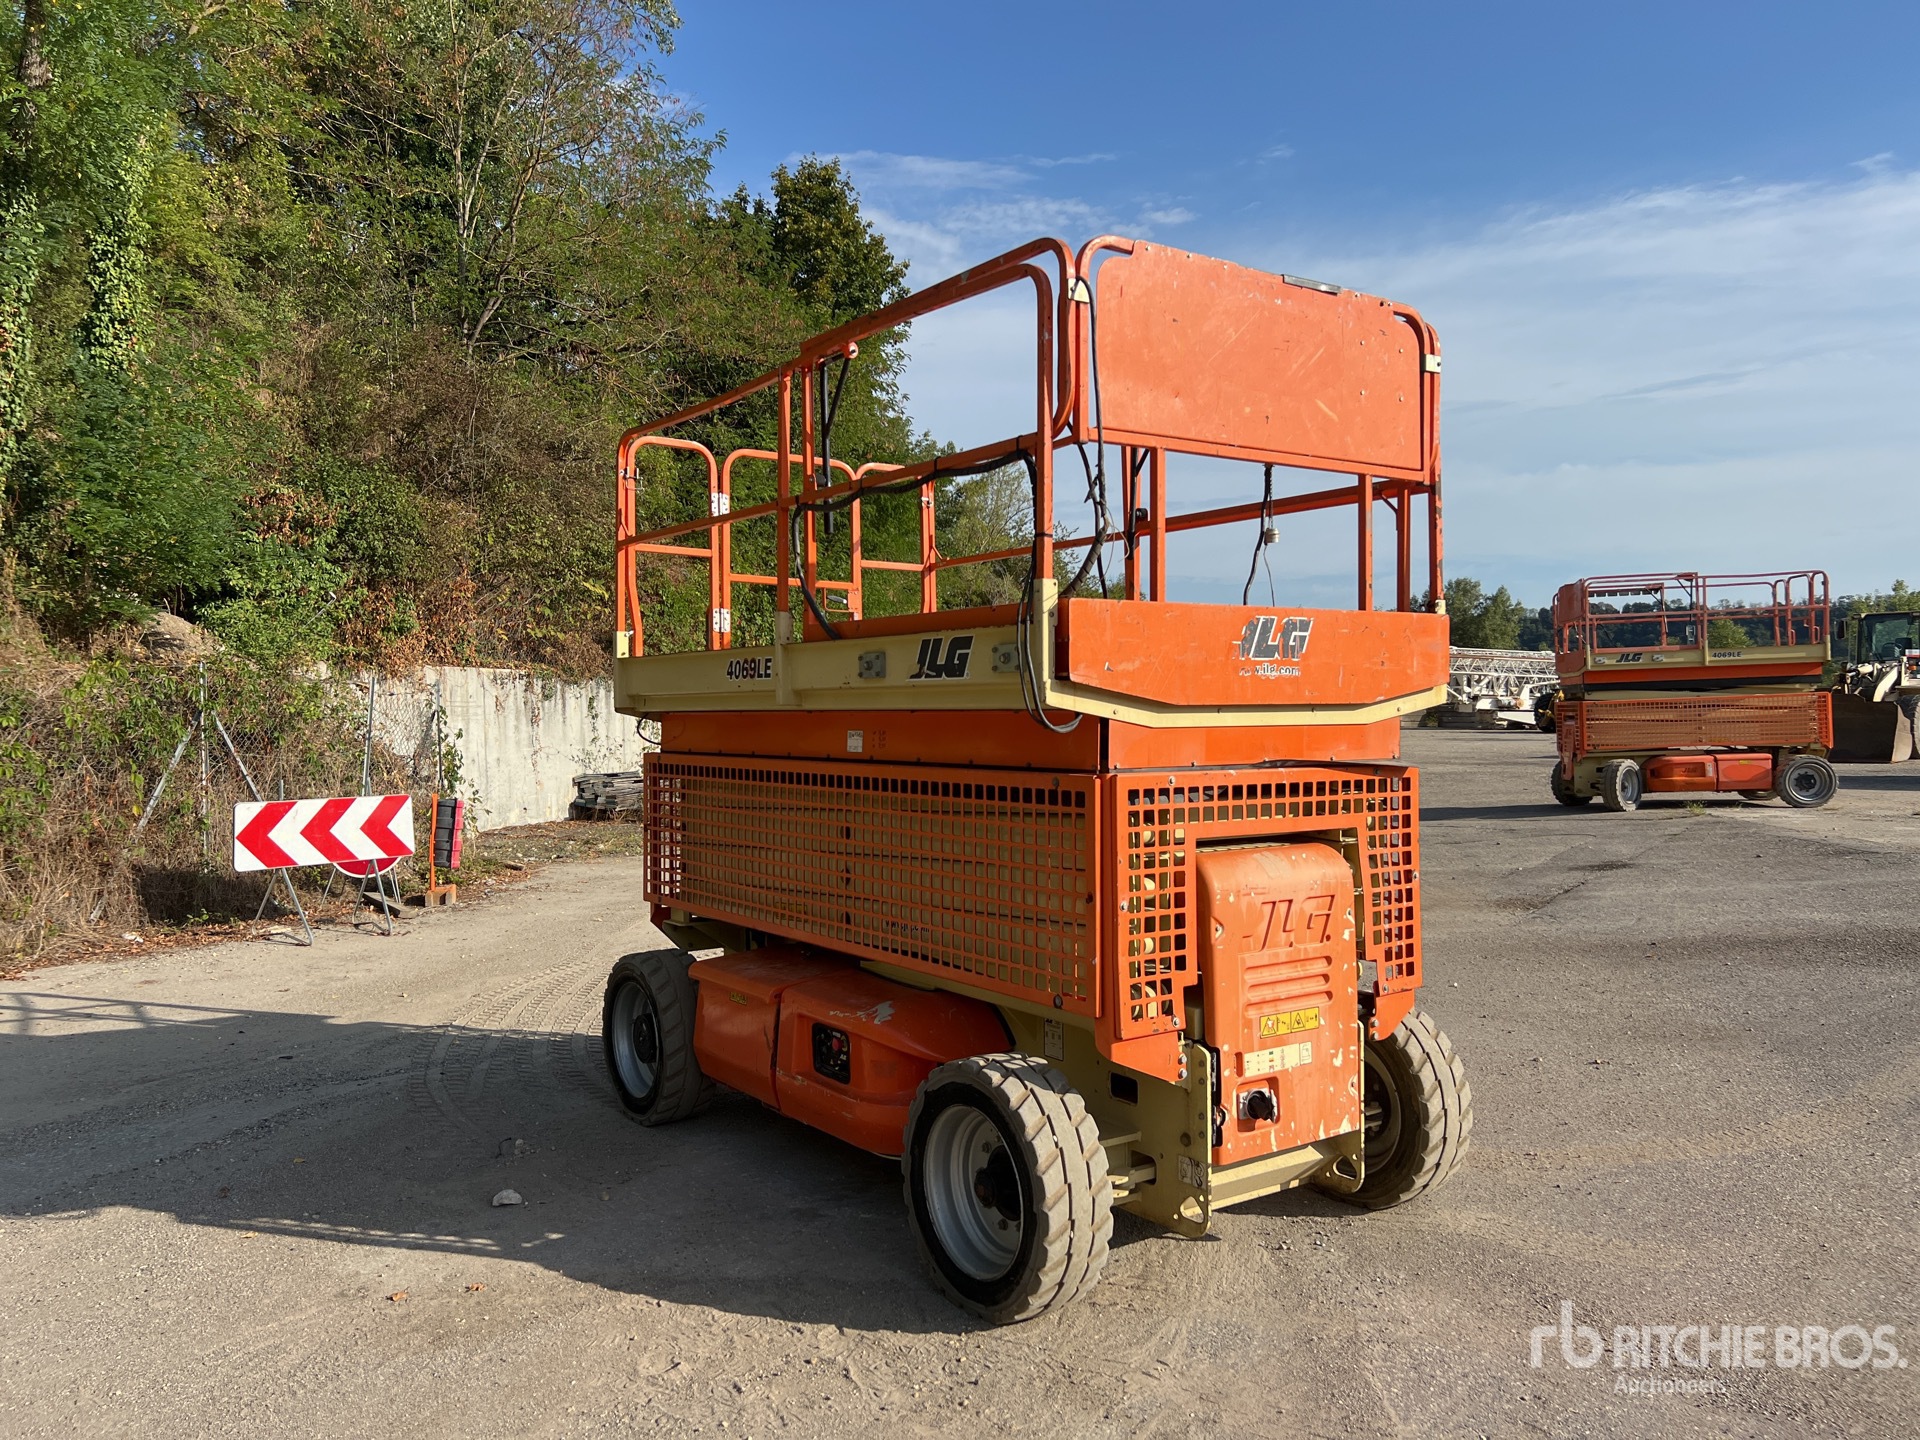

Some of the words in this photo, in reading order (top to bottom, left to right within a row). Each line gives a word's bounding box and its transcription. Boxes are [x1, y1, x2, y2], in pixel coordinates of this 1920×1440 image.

[1231, 615, 1314, 661] JLG
[908, 634, 975, 681] JLG
[1615, 652, 1643, 664] JLG
[1711, 650, 1742, 659] 4069LE
[726, 657, 773, 680] 4069LE
